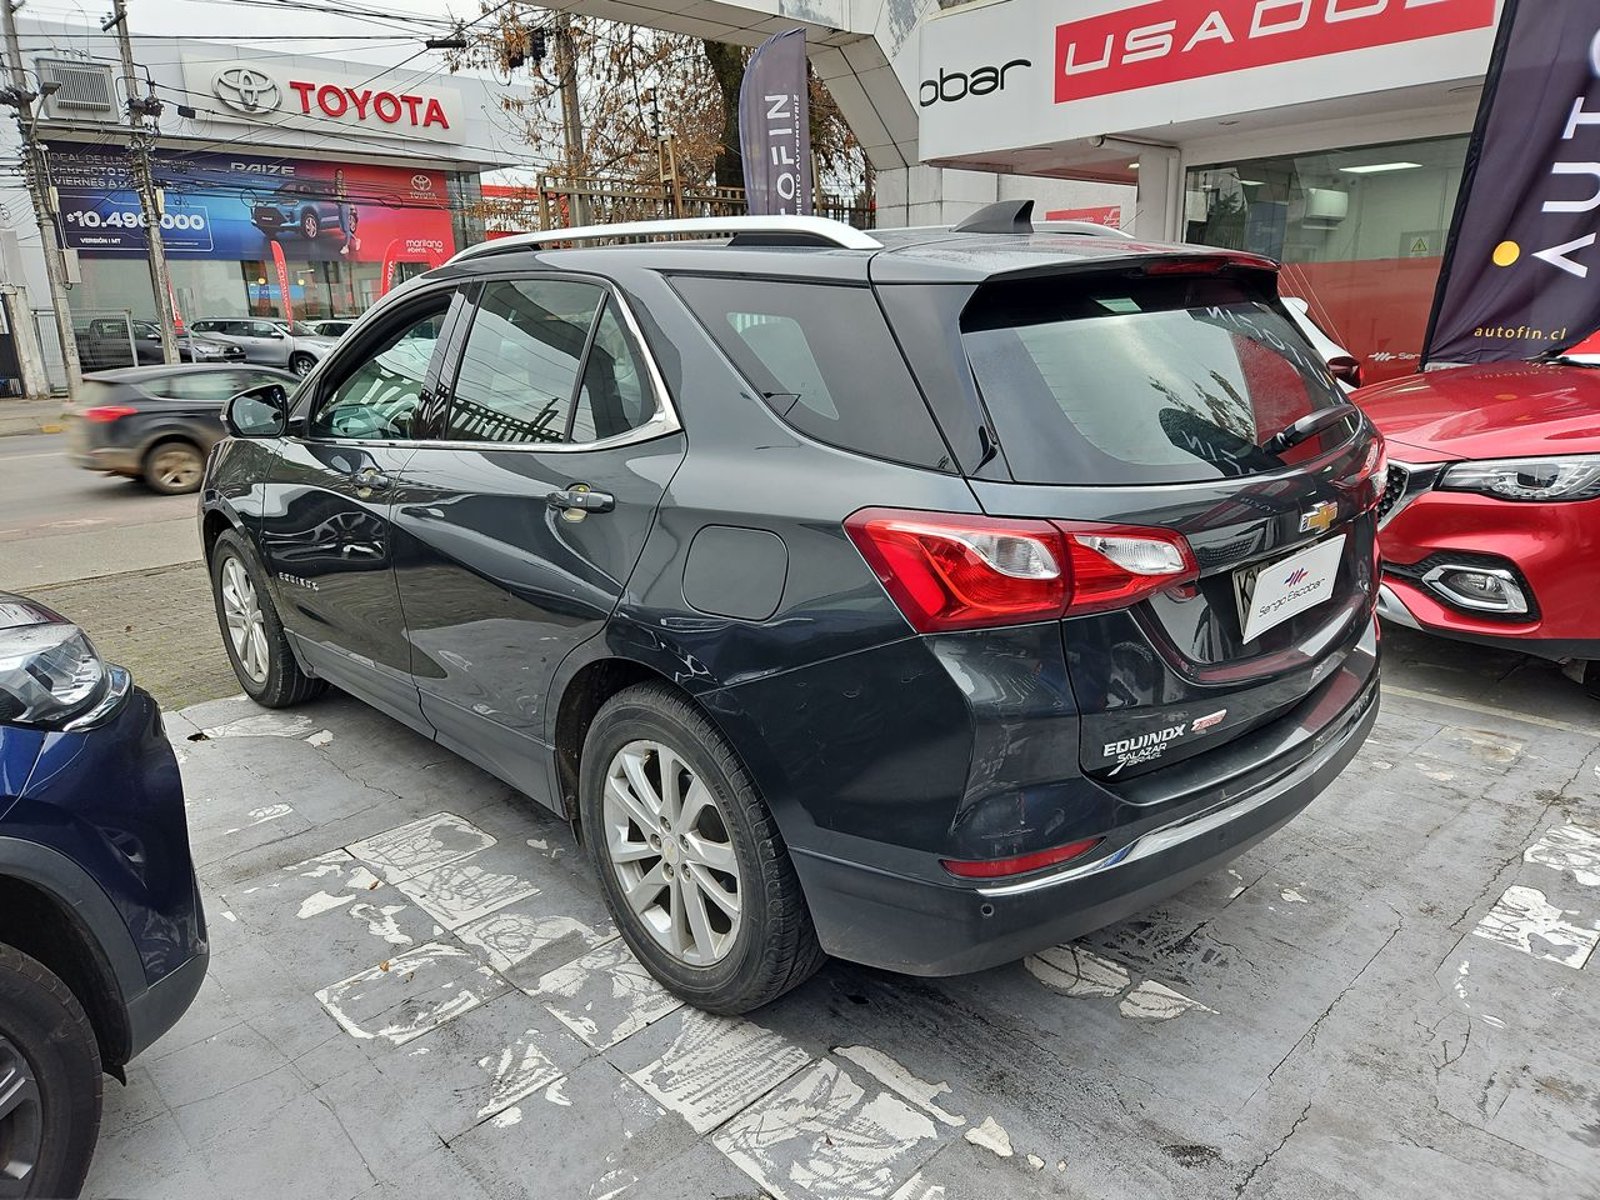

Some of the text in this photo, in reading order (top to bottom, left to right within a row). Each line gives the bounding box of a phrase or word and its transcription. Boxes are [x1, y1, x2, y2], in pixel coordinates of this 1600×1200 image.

[1064, 0, 1448, 76] USADO
[289, 80, 450, 129] TOYOTA
[230, 161, 296, 176] RAIZE
[764, 94, 796, 215] OFIN
[53, 176, 106, 187] VIERNES
[1474, 325, 1567, 341] autofin.cl
[1103, 723, 1187, 757] EQUINOX
[1116, 742, 1167, 764] SALAZAR
